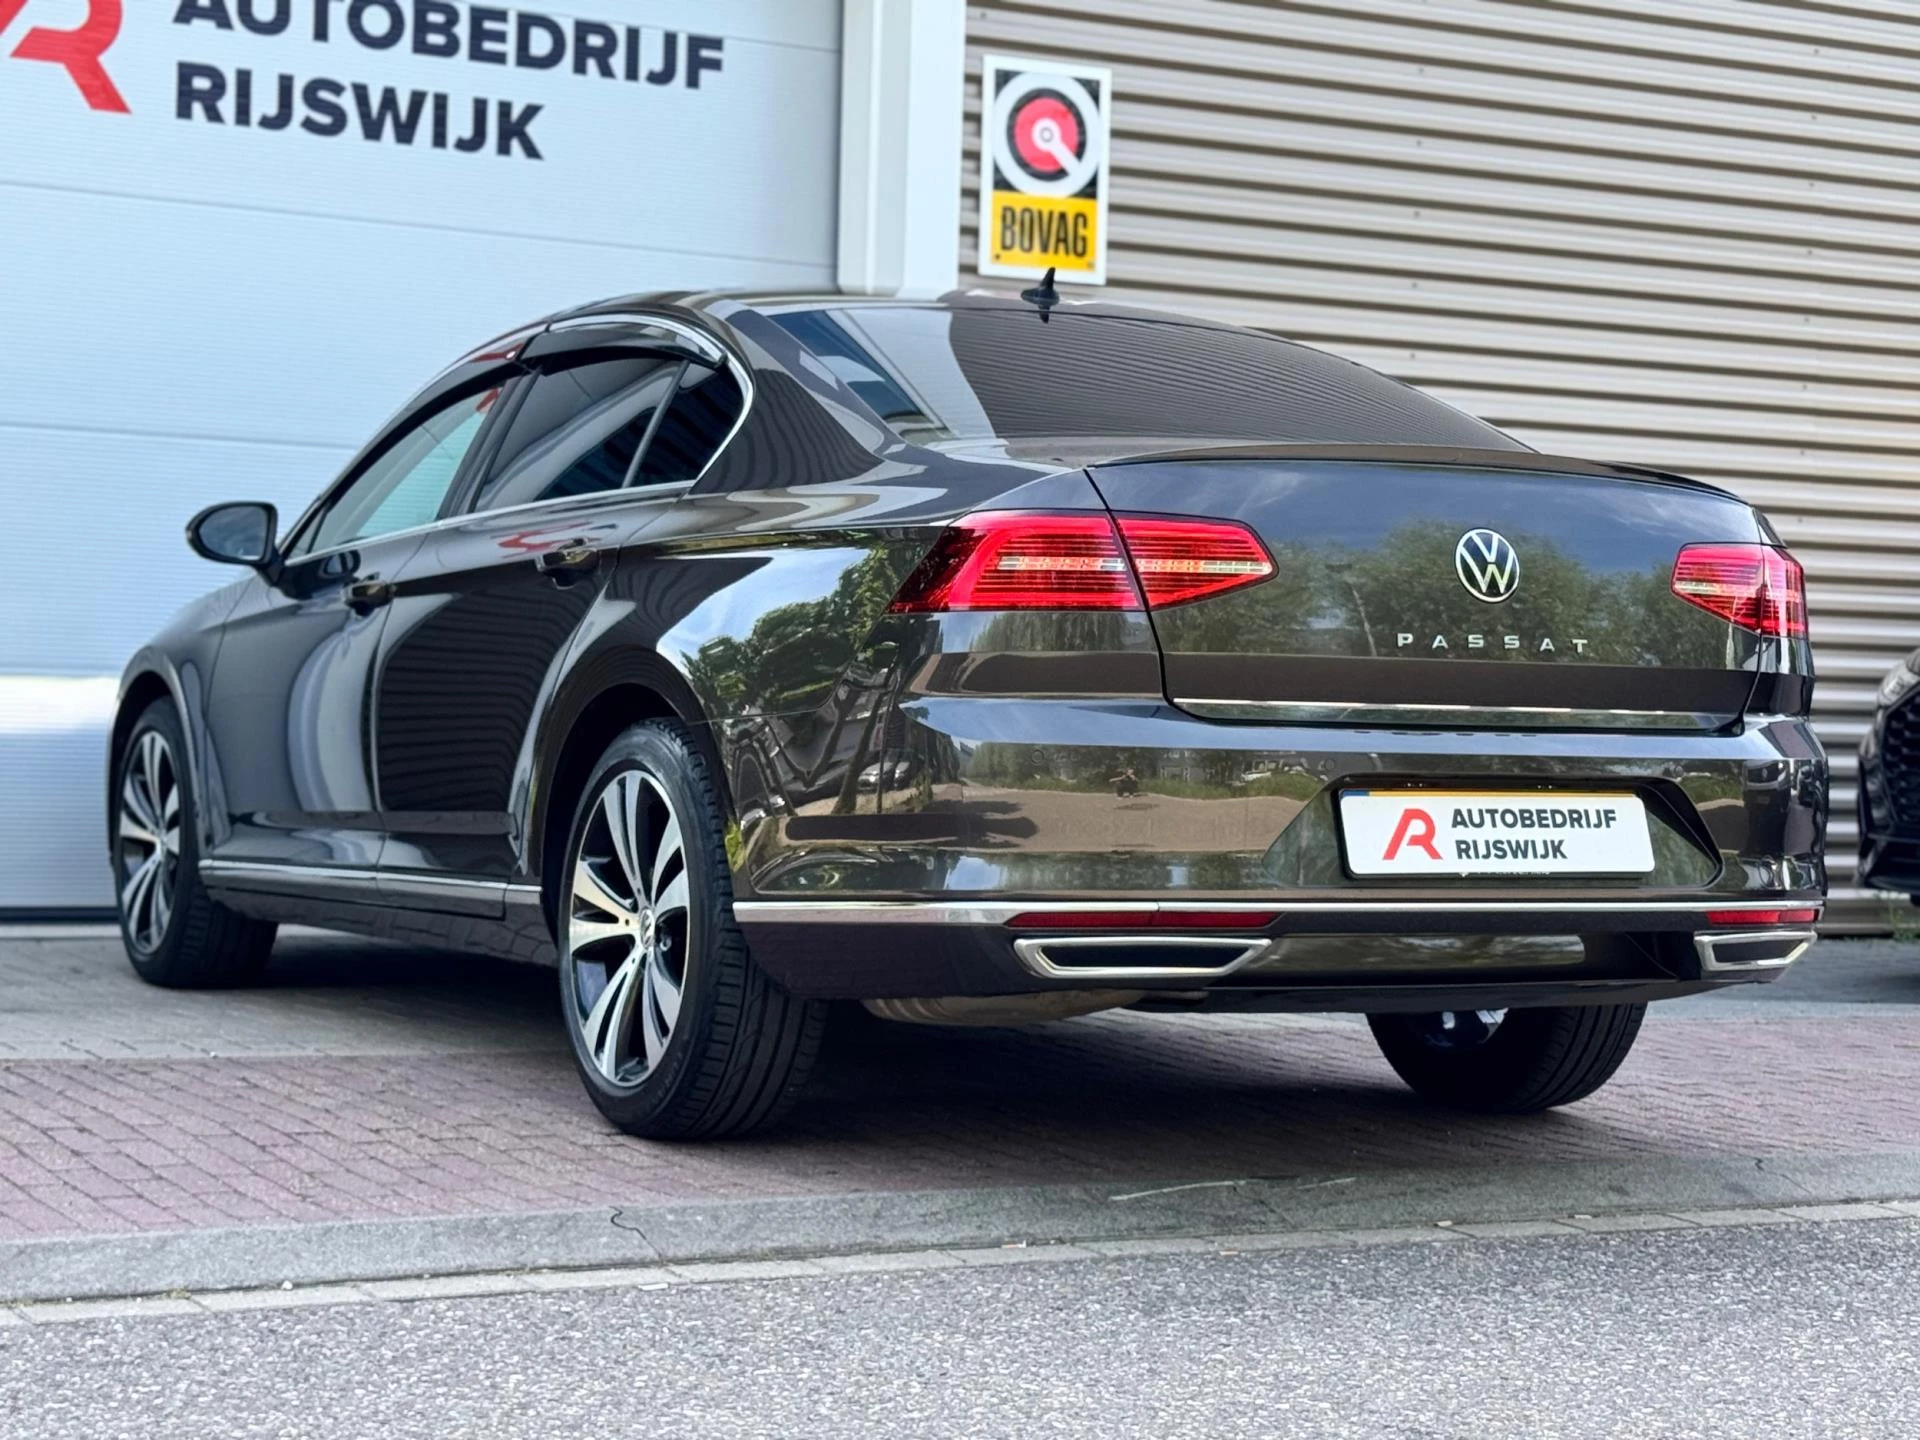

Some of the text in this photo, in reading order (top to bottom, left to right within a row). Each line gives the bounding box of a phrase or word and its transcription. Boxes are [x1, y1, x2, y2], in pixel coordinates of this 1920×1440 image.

[175, 60, 545, 161] RIJSWIJK
[1000, 206, 1088, 258] BOVAG
[1396, 632, 1588, 654] PASSAT
[1451, 808, 1617, 829] AUTOBEDRIJF
[1455, 839, 1568, 860] RIJSWIJK
